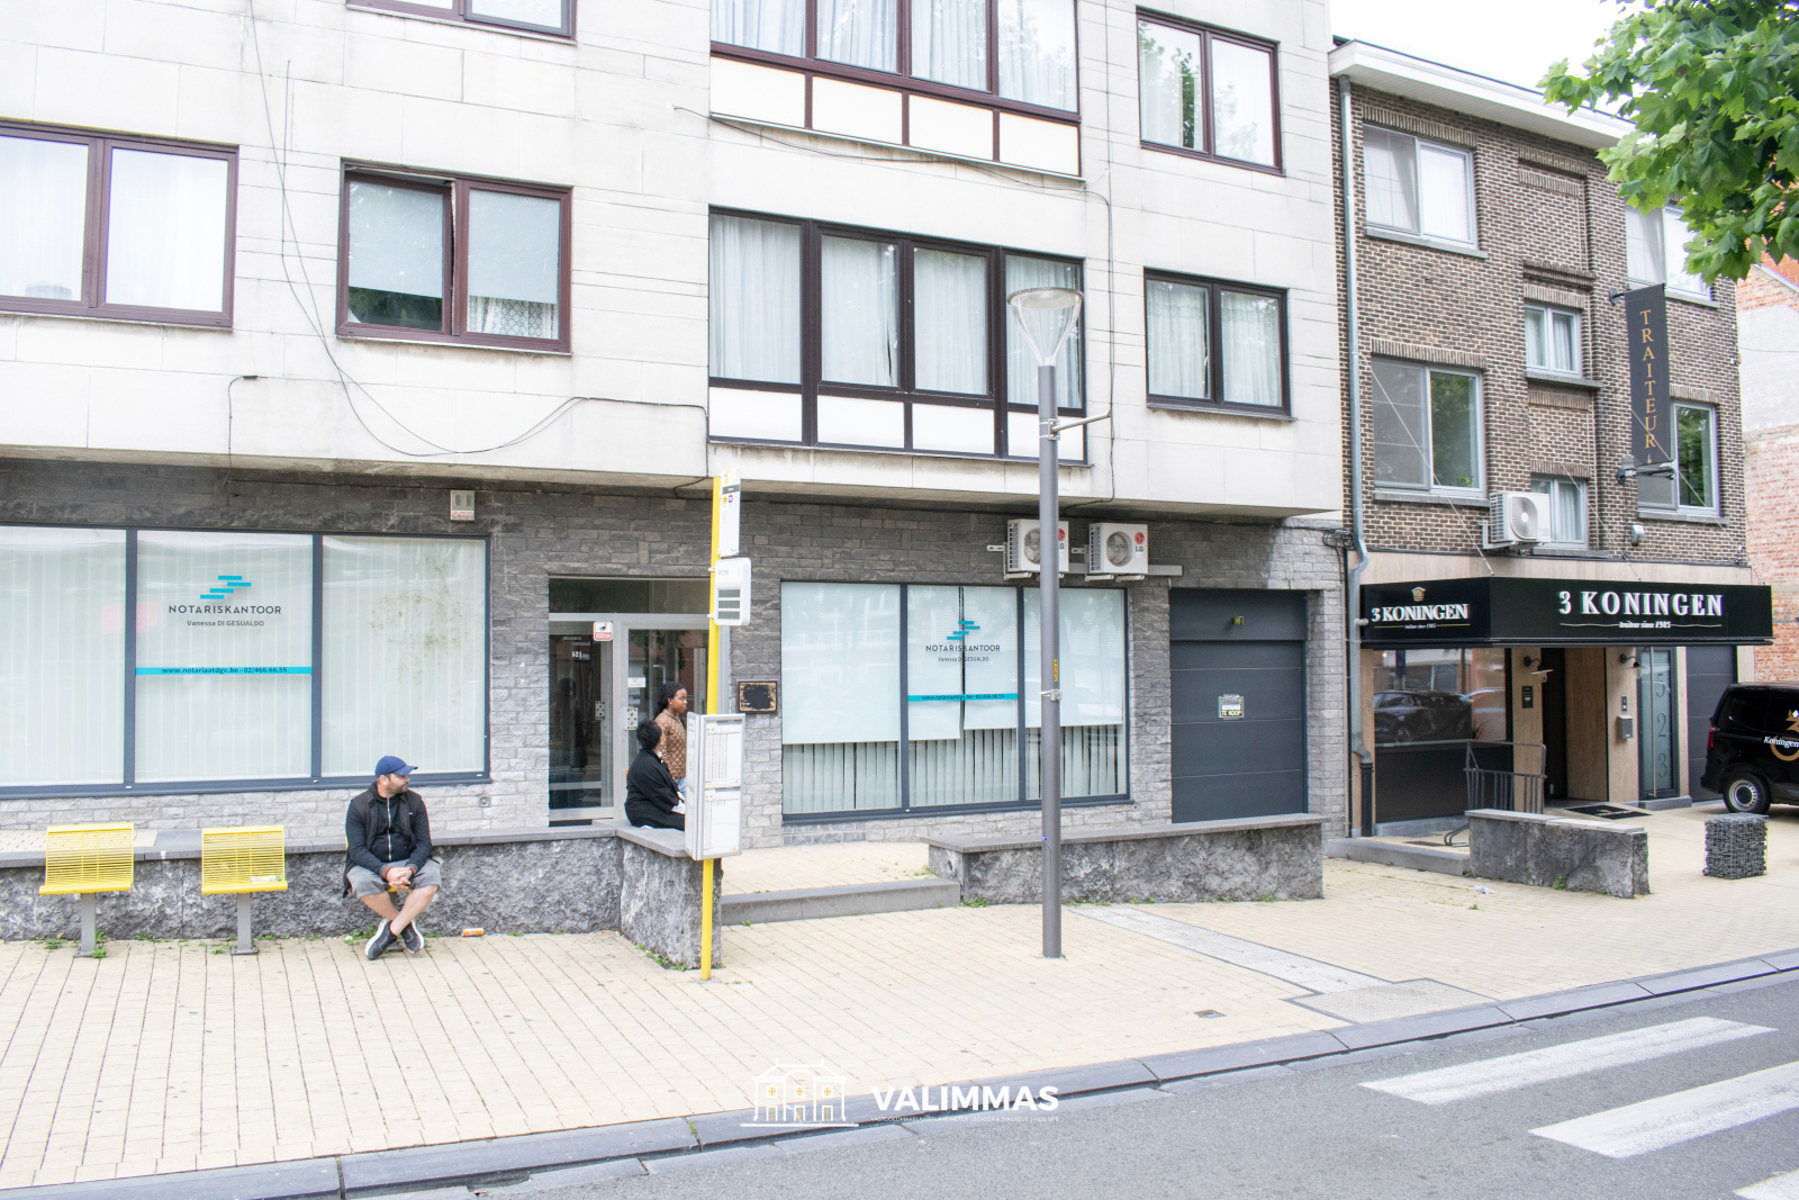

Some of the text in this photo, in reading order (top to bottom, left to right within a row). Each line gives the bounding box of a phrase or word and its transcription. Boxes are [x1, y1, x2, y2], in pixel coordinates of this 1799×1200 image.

[1640, 309, 1657, 449] TRAITEUR
[1135, 545, 1144, 553] LG
[168, 604, 283, 615] NOTARISKANTOOR
[1559, 591, 1723, 616] 3 KONINGEN
[1371, 603, 1470, 622] 3 KONINGEN
[161, 667, 239, 676] www.notariaatdgv.be
[243, 666, 288, 675] 02/466.66.55
